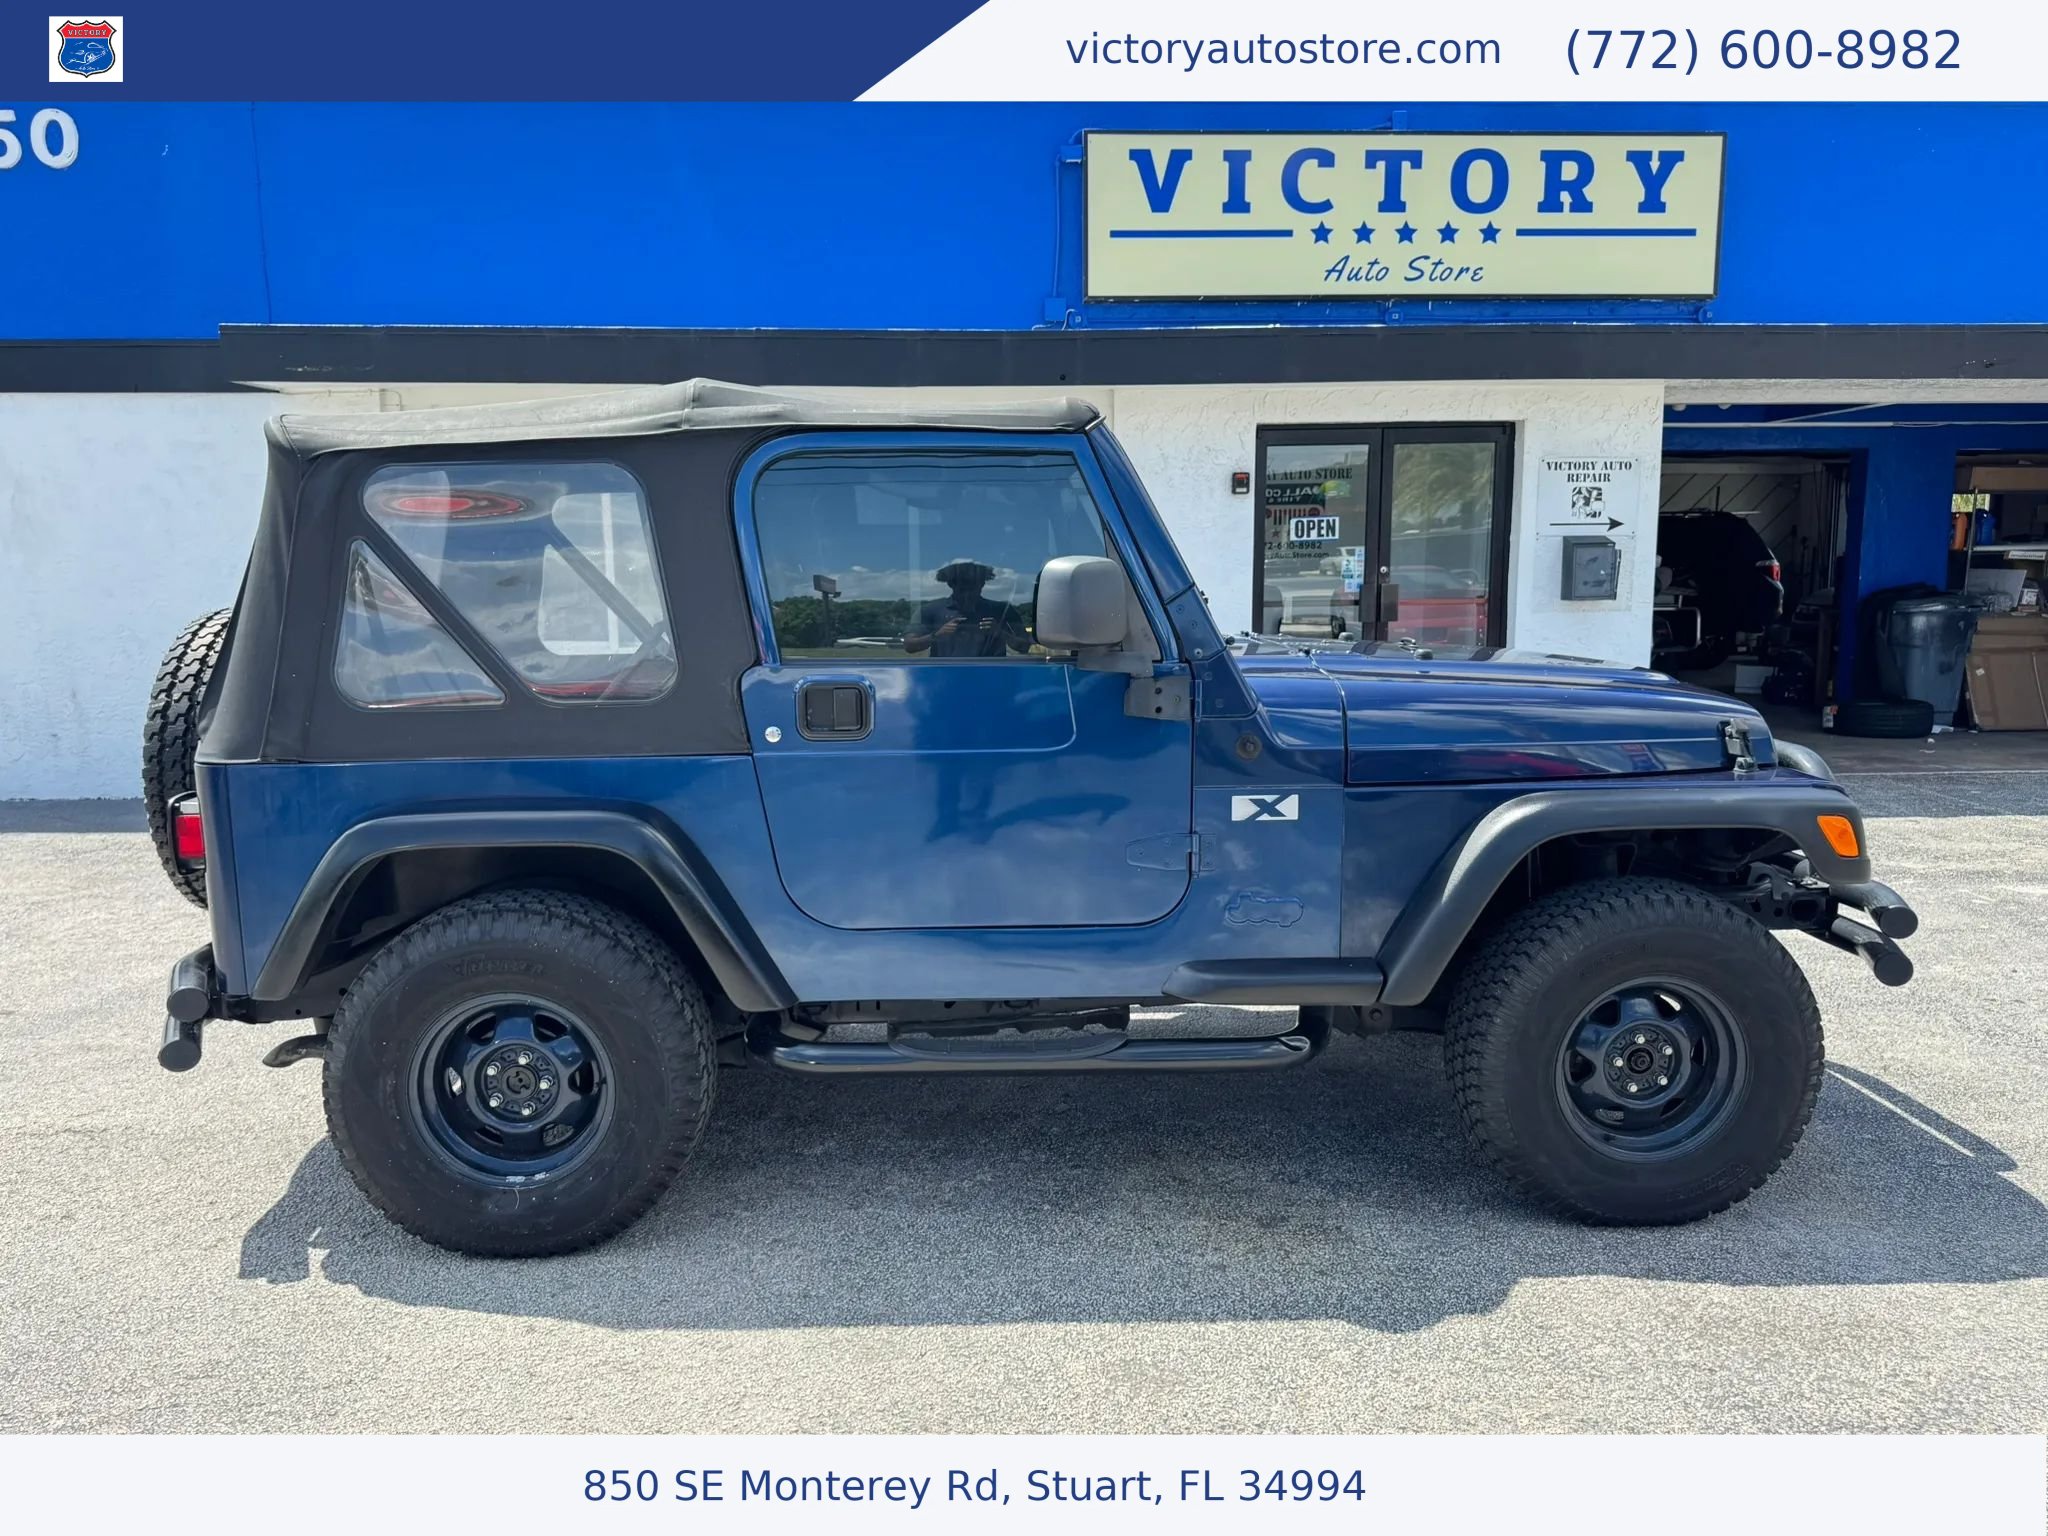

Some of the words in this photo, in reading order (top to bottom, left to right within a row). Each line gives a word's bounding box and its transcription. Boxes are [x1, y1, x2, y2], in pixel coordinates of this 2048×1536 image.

[1128, 147, 1685, 215] VICTORY
[1323, 254, 1391, 284] Auto
[1403, 254, 1485, 283] Store
[1281, 470, 1312, 481] AUTO
[1314, 467, 1353, 480] STORE
[1546, 461, 1598, 471] VICTORY
[1601, 461, 1633, 471] AUTO
[1567, 473, 1612, 483] REPAIR
[1294, 518, 1337, 540] OPEN
